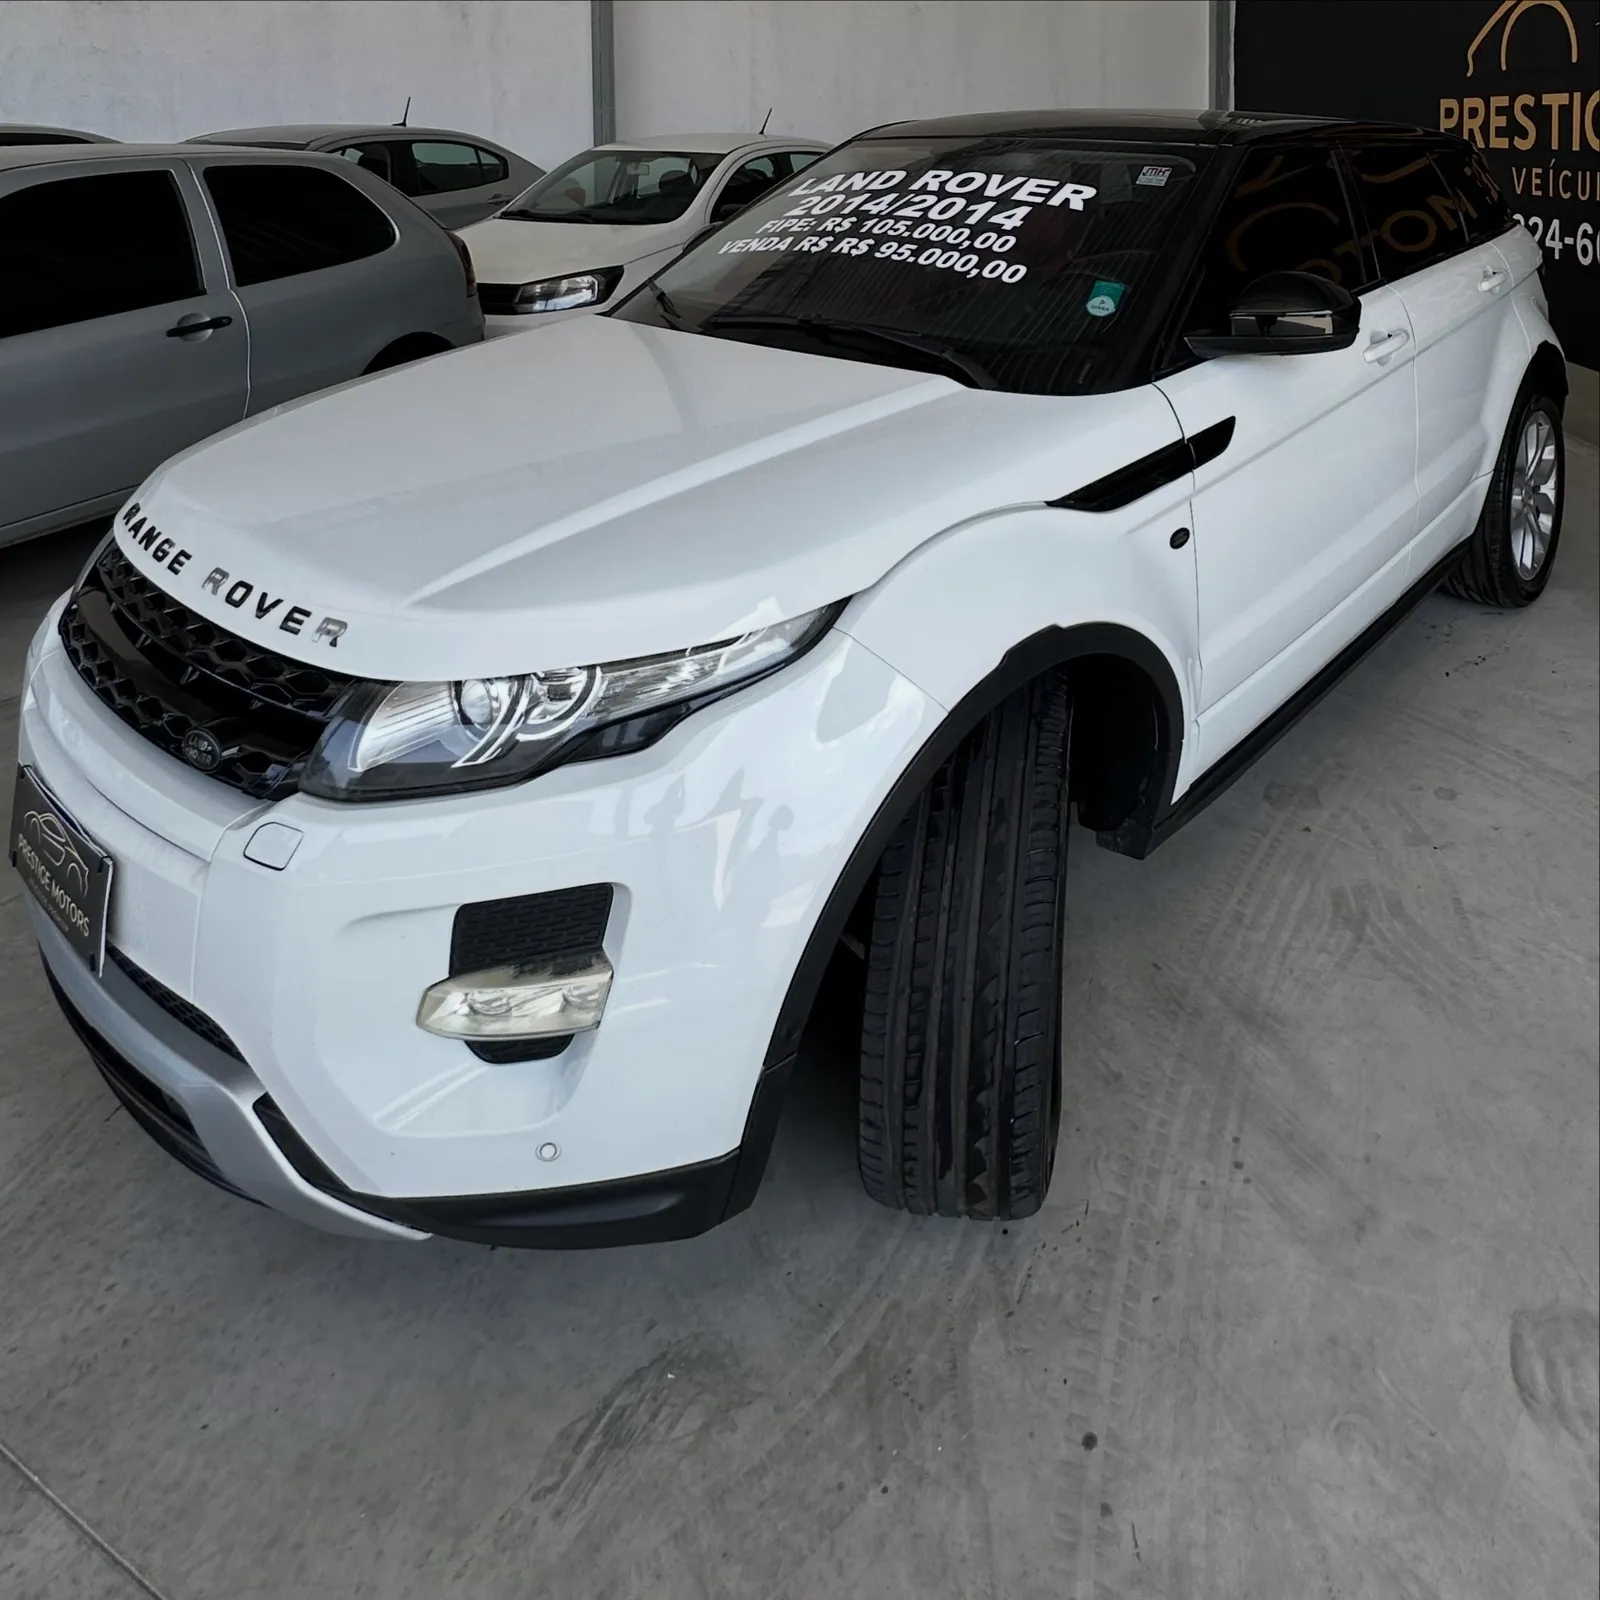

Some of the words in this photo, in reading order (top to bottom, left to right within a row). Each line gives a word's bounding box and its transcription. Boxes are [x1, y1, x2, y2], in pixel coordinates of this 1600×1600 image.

[788, 170, 907, 197] LAND
[908, 170, 1097, 211] ROVER
[1511, 158, 1600, 202] VEÍCU
[756, 217, 817, 234] FIPE:
[816, 216, 857, 233] R$
[859, 217, 1017, 252] 105.000,00
[783, 193, 1033, 230] 2014/2014
[717, 236, 794, 255] VENDA
[793, 236, 834, 253] R$
[831, 237, 875, 257] R$
[874, 241, 1027, 284] 95.000,00
[1512, 213, 1600, 266] 24-6
[122, 502, 193, 576] RANGE
[201, 566, 348, 648] ROVER
[51, 879, 90, 937] MOTORS
